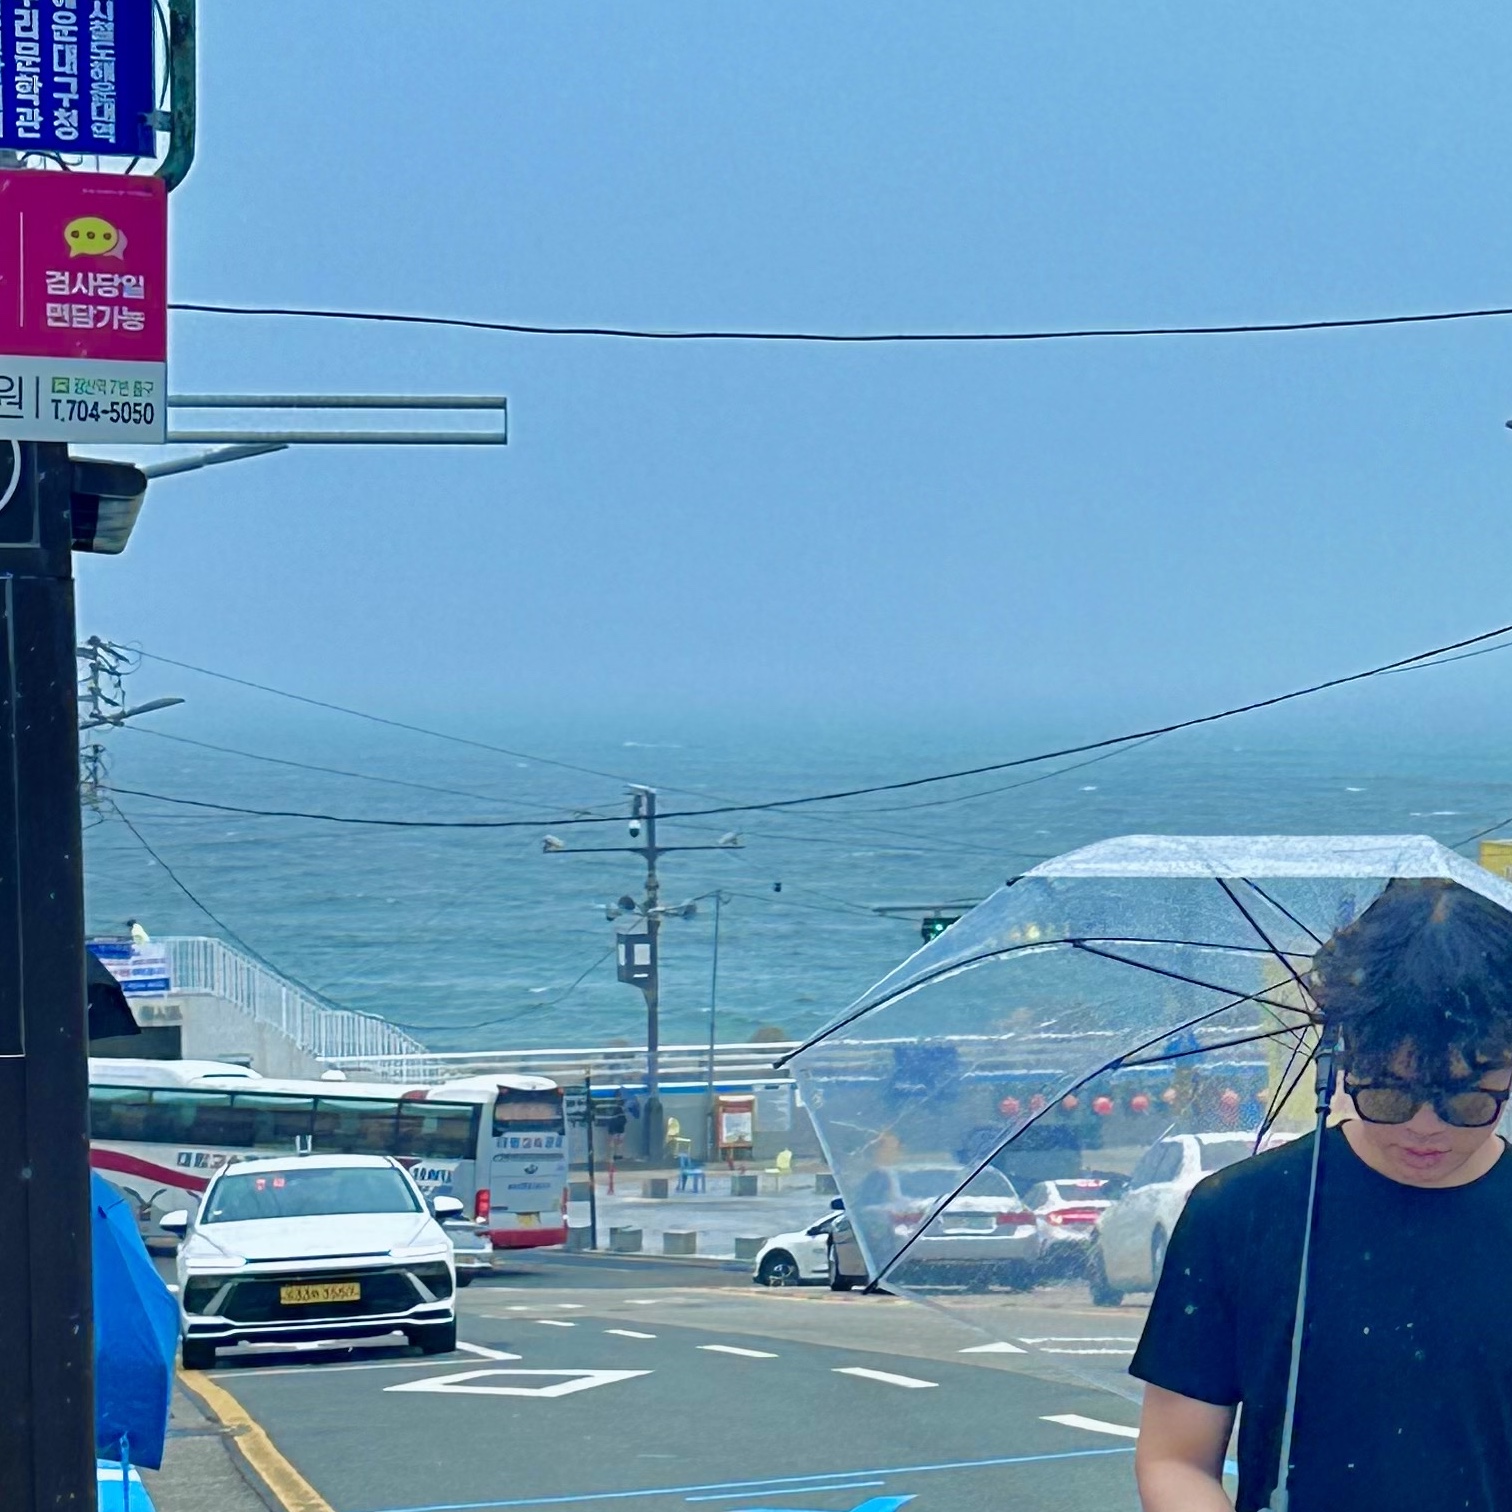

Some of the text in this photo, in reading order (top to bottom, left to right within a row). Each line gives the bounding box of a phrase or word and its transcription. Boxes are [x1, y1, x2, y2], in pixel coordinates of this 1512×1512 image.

[14, 0, 43, 139] 리문학관
[45, 270, 145, 299] 검사당일
[46, 303, 145, 331] 면담가능
[51, 399, 155, 425] T.704-5050
